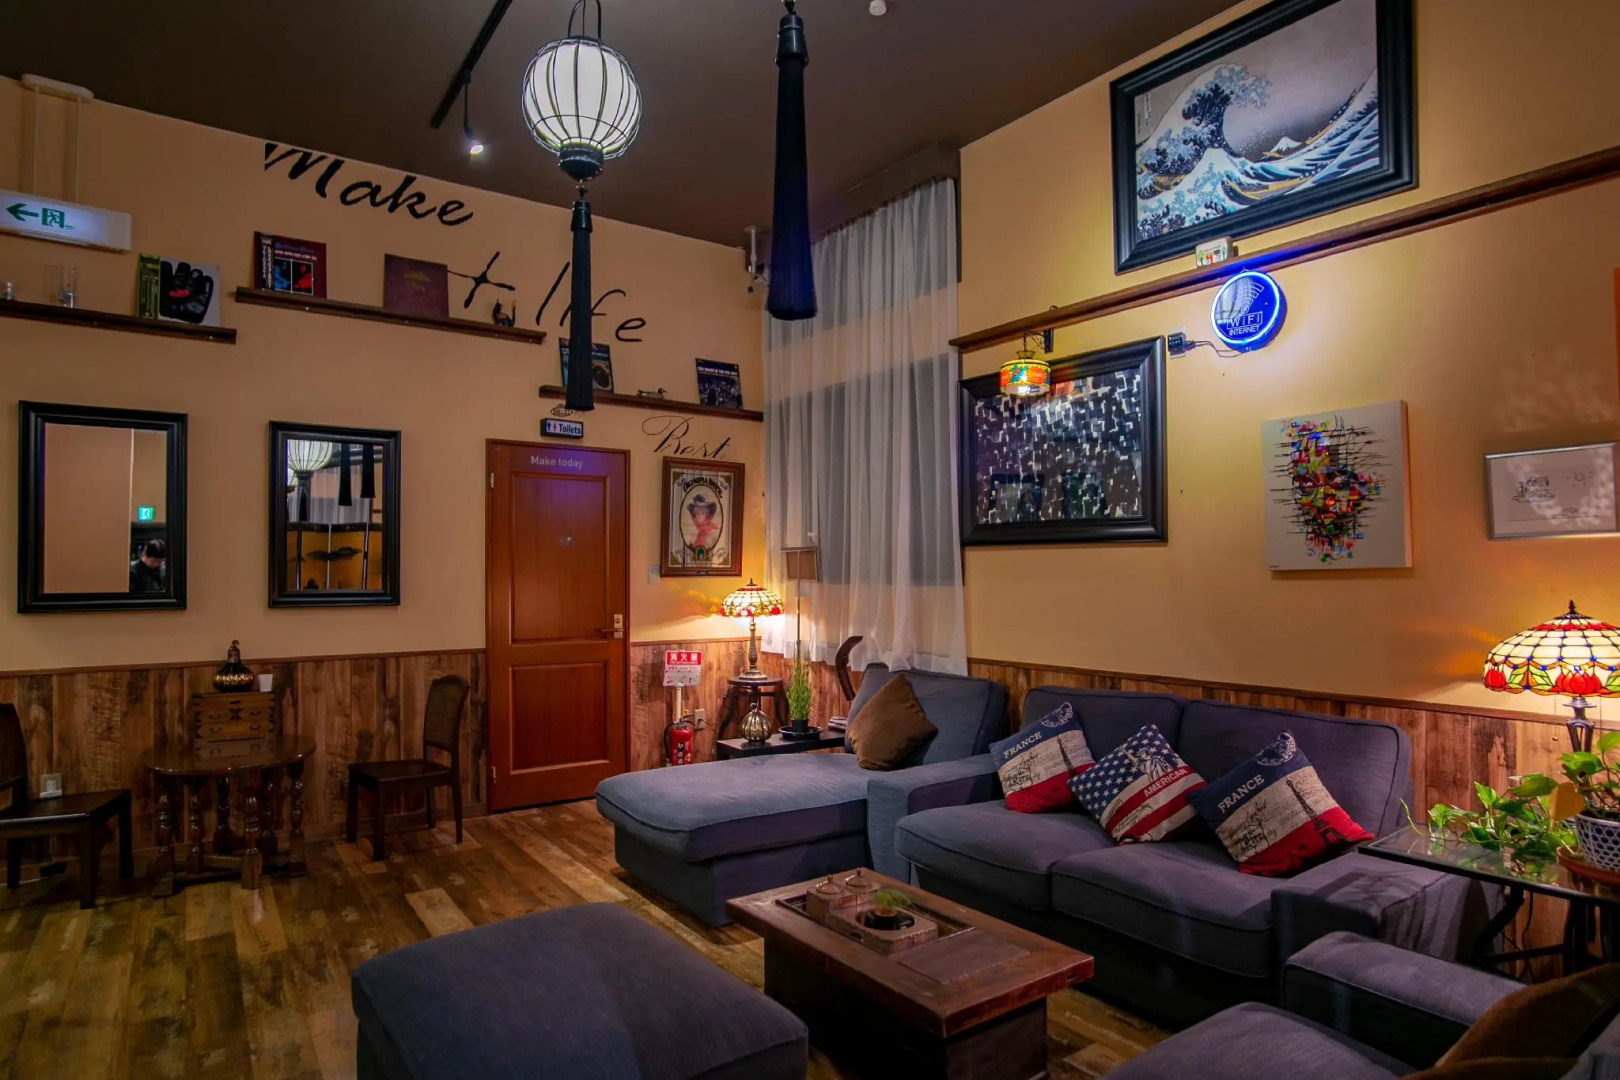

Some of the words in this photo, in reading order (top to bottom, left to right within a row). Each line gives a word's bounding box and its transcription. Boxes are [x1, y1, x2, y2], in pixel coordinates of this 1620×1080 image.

[265, 142, 474, 226] Make
[1229, 325, 1259, 336] INTERNET
[559, 424, 581, 435] Toilets
[531, 456, 556, 466] Make
[559, 458, 583, 469] today
[1003, 731, 1043, 759] FRANCE
[1144, 768, 1189, 797] AMERICAN
[1217, 774, 1265, 814] FRANCE
